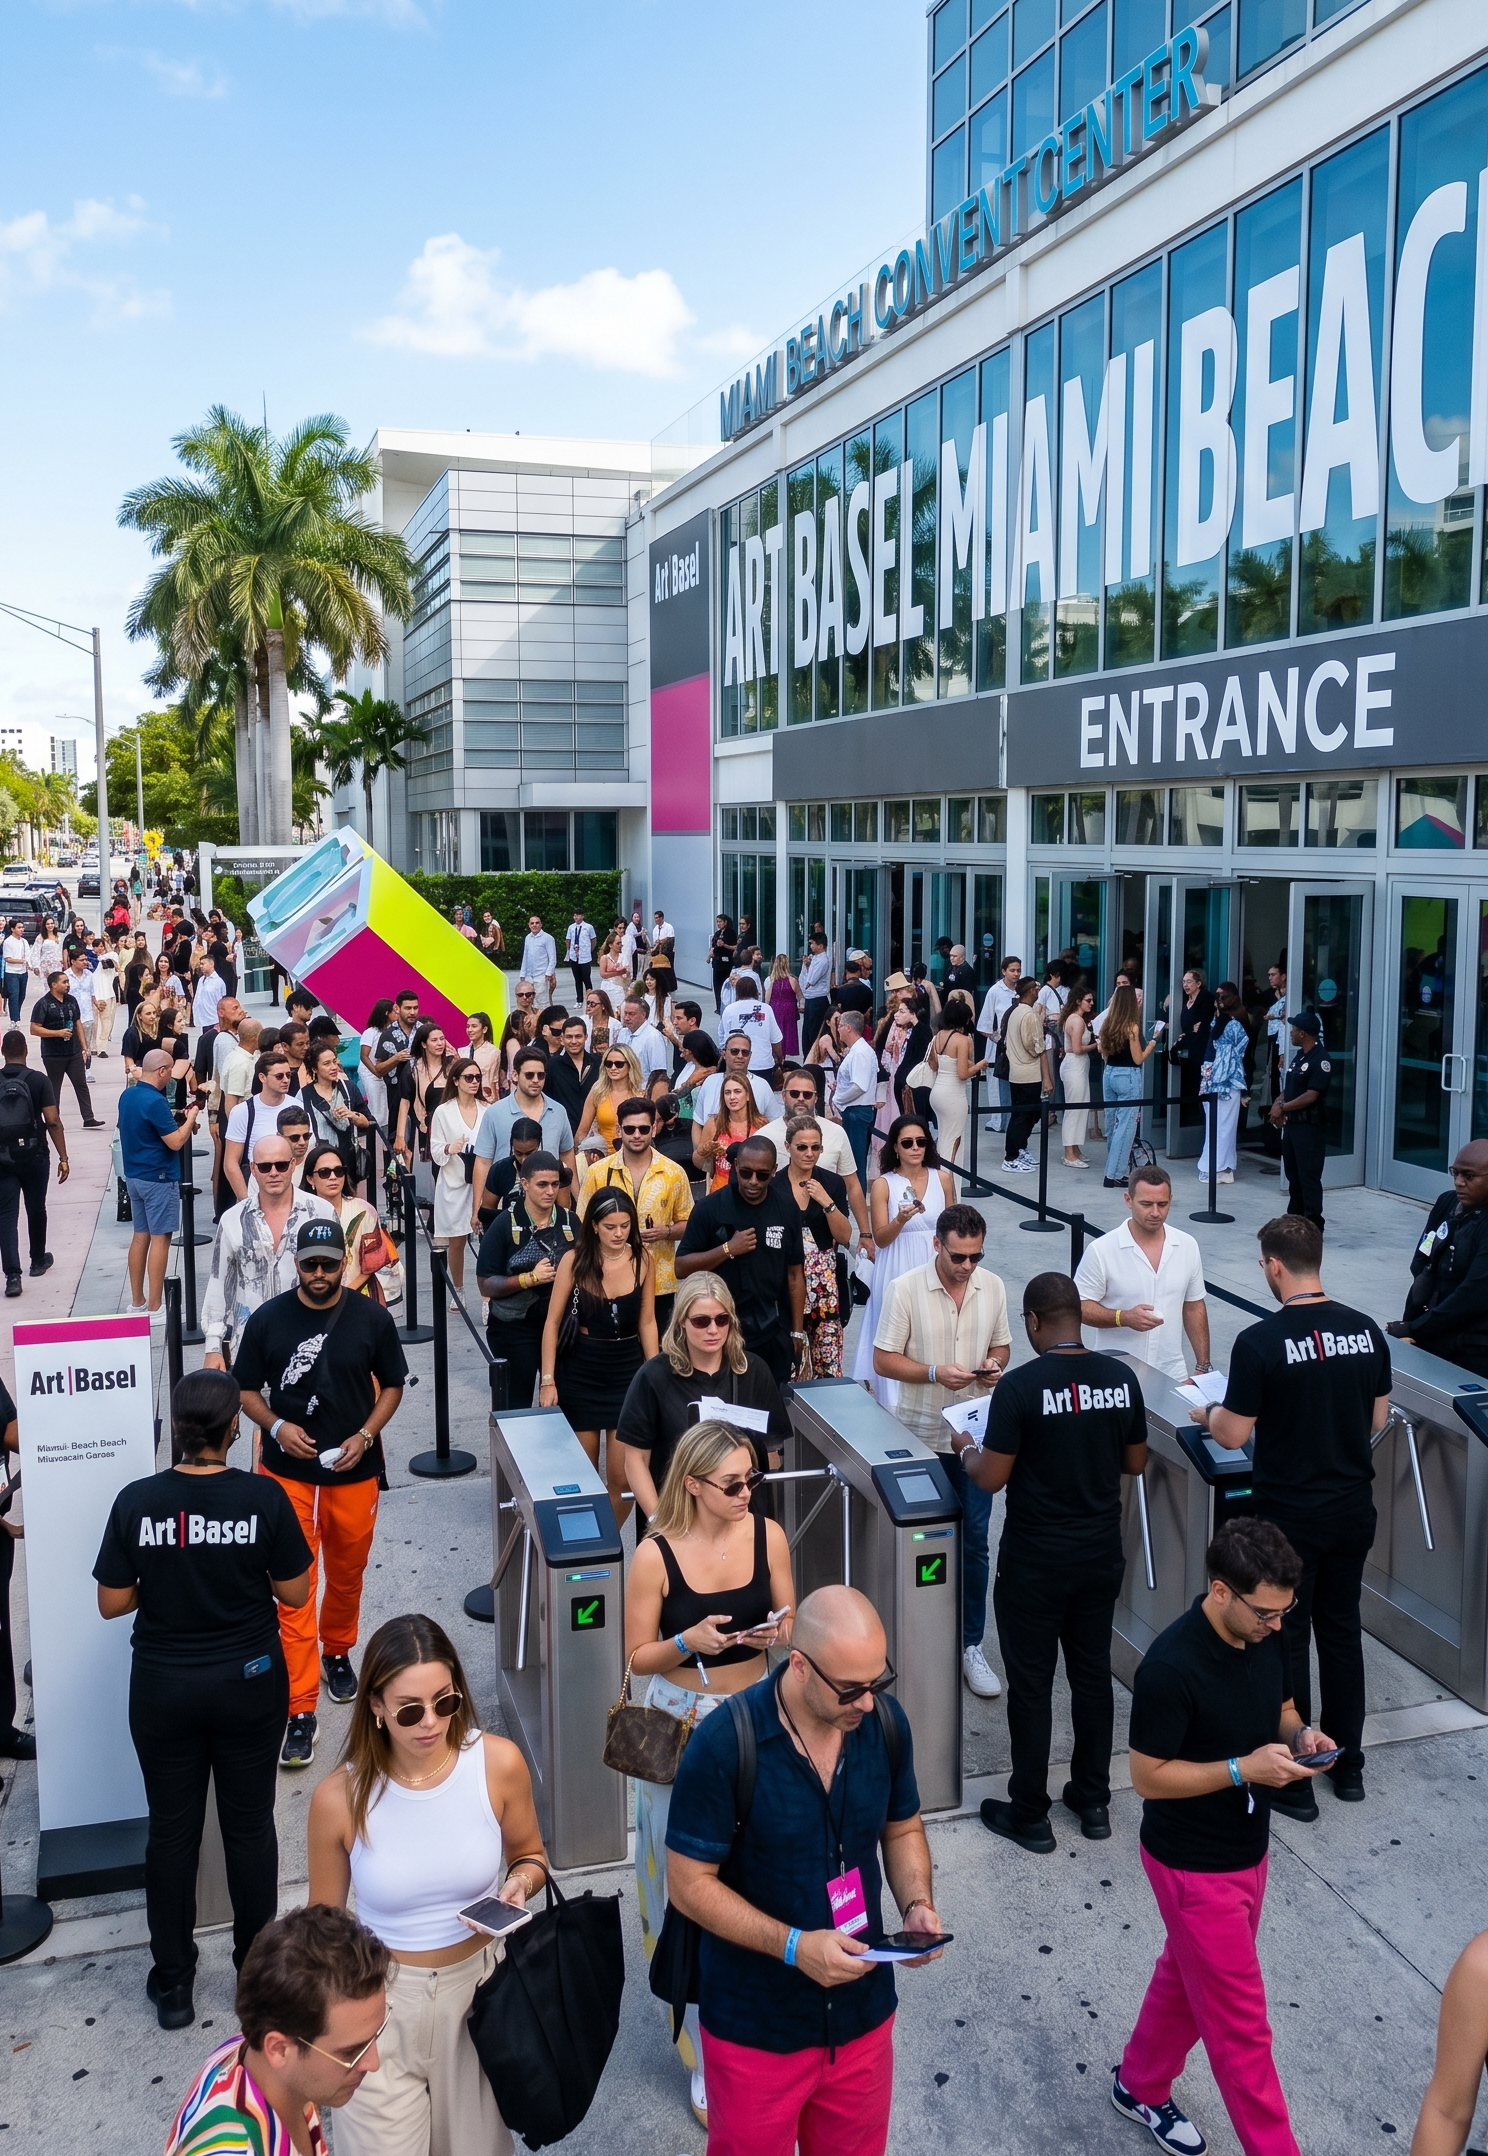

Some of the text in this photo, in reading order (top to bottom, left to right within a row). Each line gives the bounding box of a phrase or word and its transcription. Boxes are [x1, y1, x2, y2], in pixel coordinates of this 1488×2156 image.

[720, 26, 1209, 442] MIAMI BEACH CONVENT CENTER
[725, 167, 1488, 687] ART BASEL MIAMI BEAC
[1080, 651, 1397, 770] ENTRANCE
[71, 1440, 98, 1450] Beach
[100, 1438, 127, 1447] Beach
